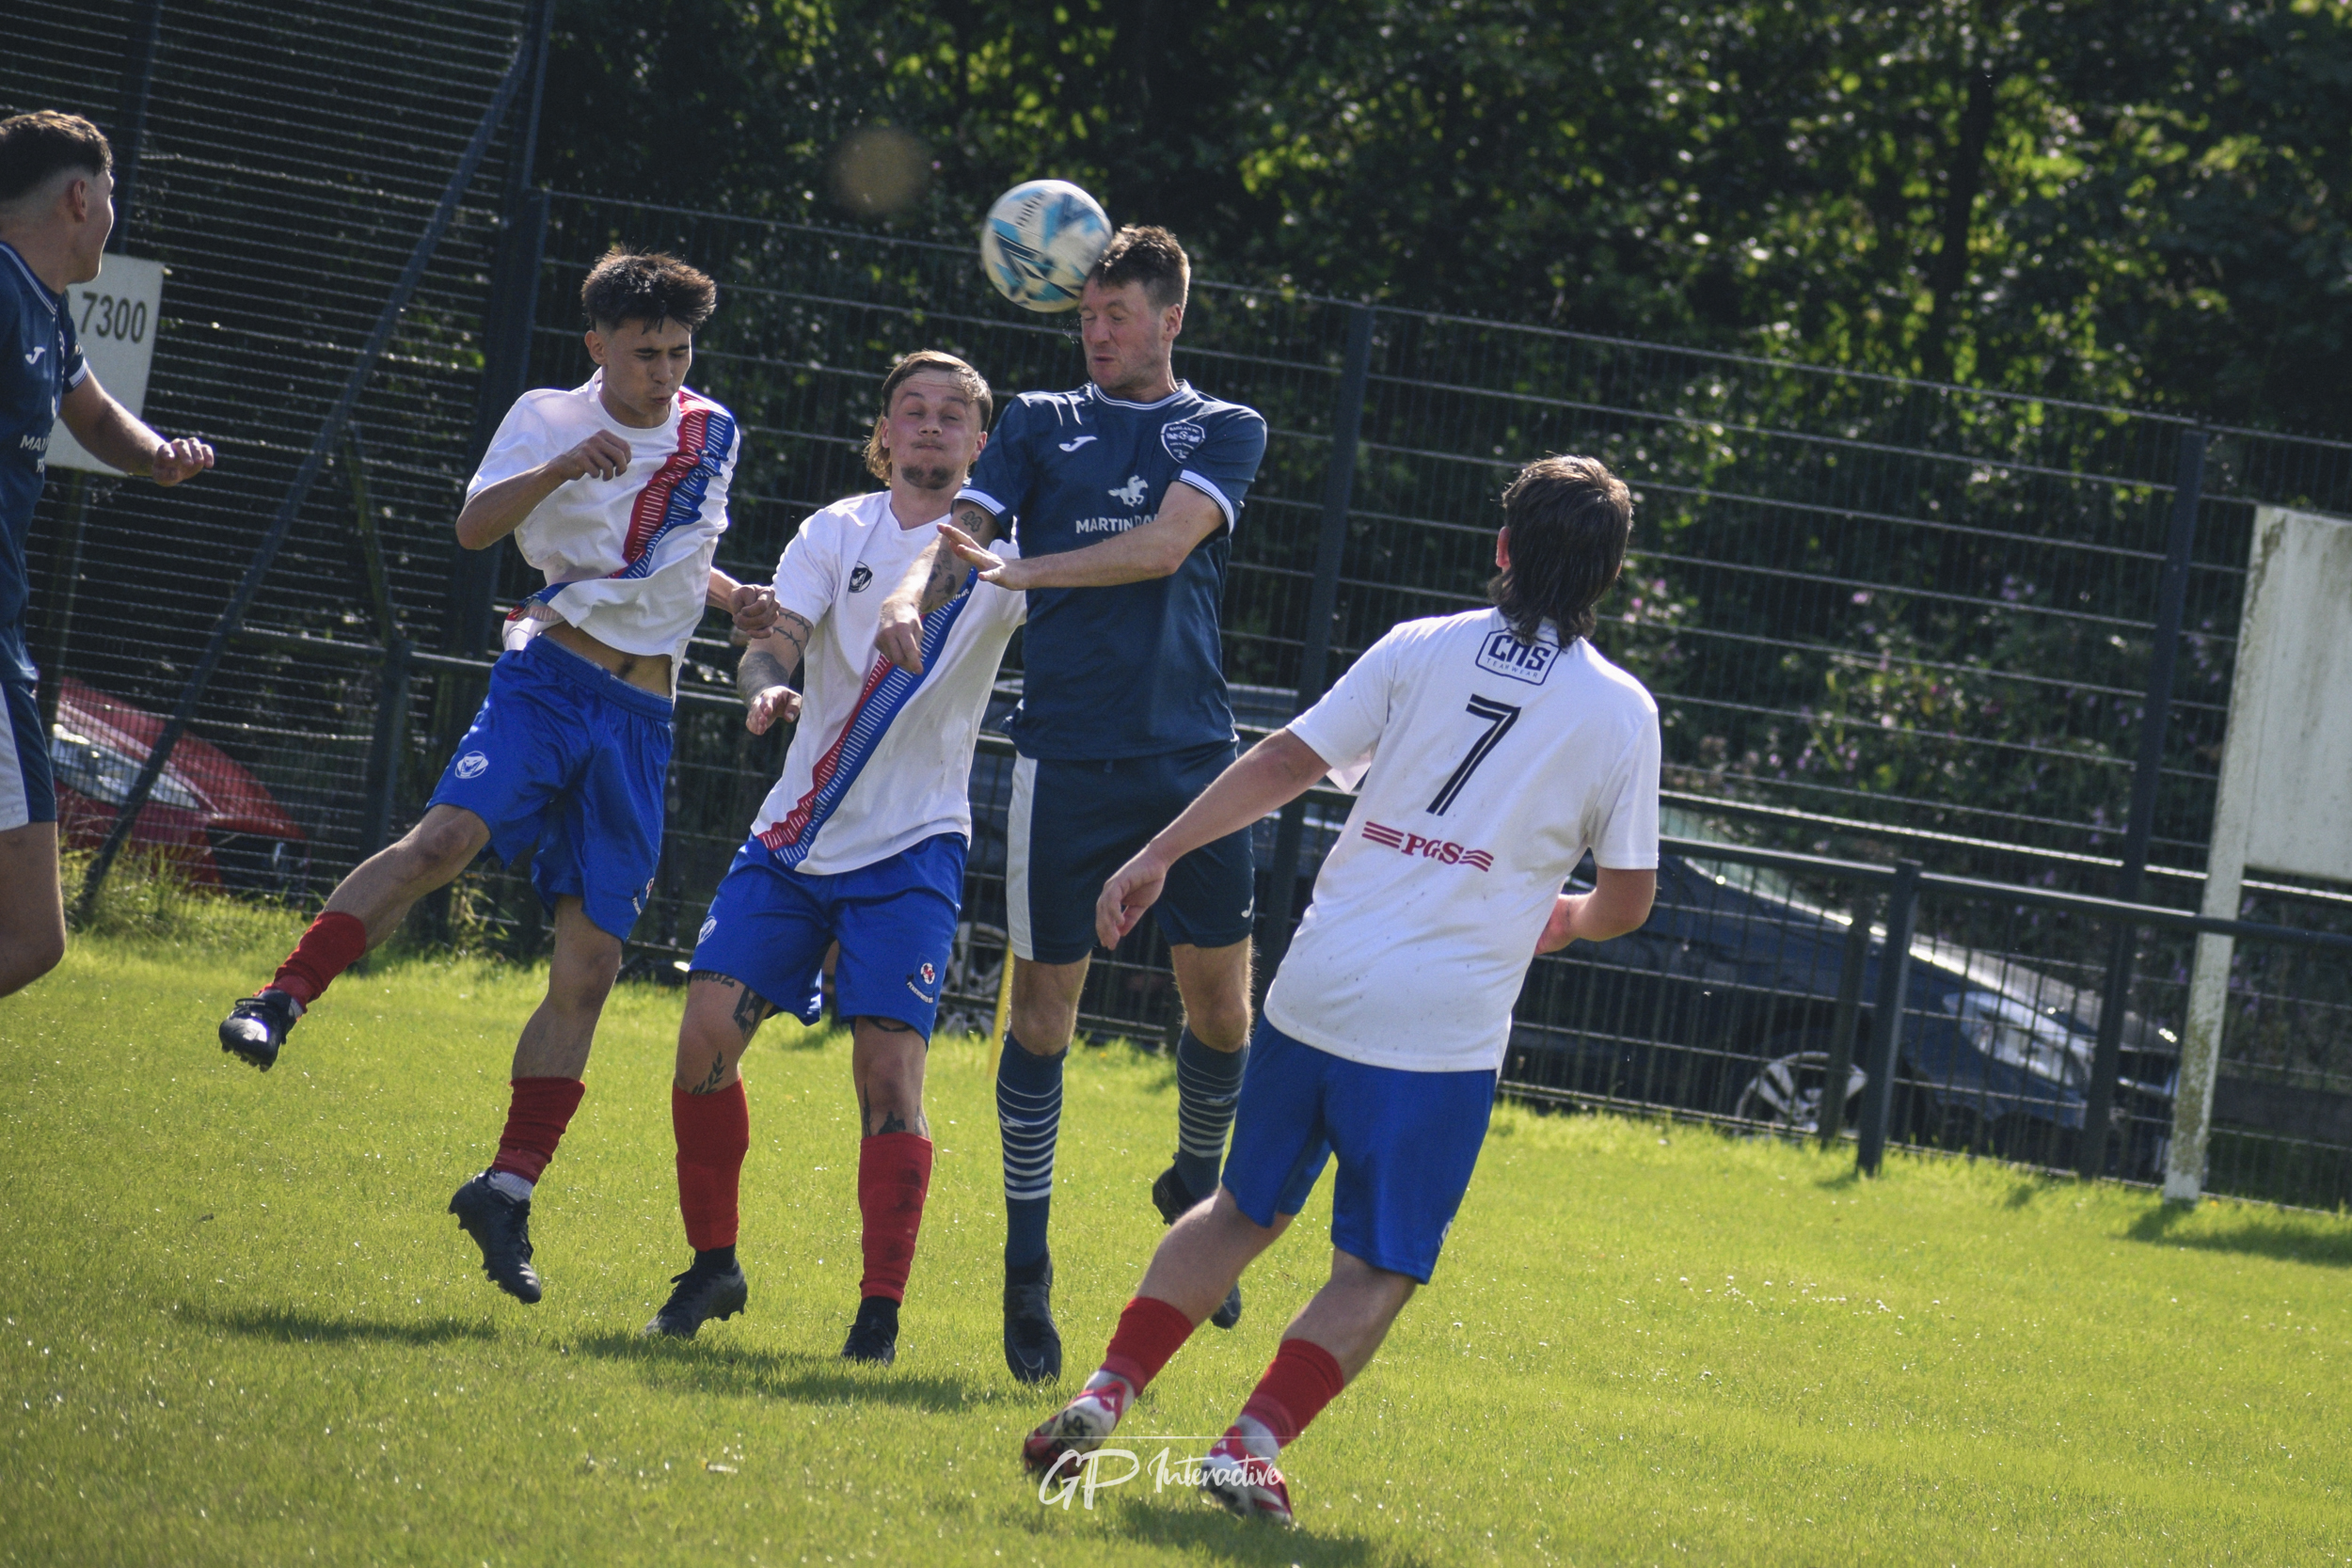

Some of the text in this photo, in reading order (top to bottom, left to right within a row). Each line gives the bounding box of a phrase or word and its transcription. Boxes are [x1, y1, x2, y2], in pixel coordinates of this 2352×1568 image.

[81, 291, 147, 344] 7300
[1425, 693, 1521, 816] 7
[1401, 832, 1464, 865] PGS
